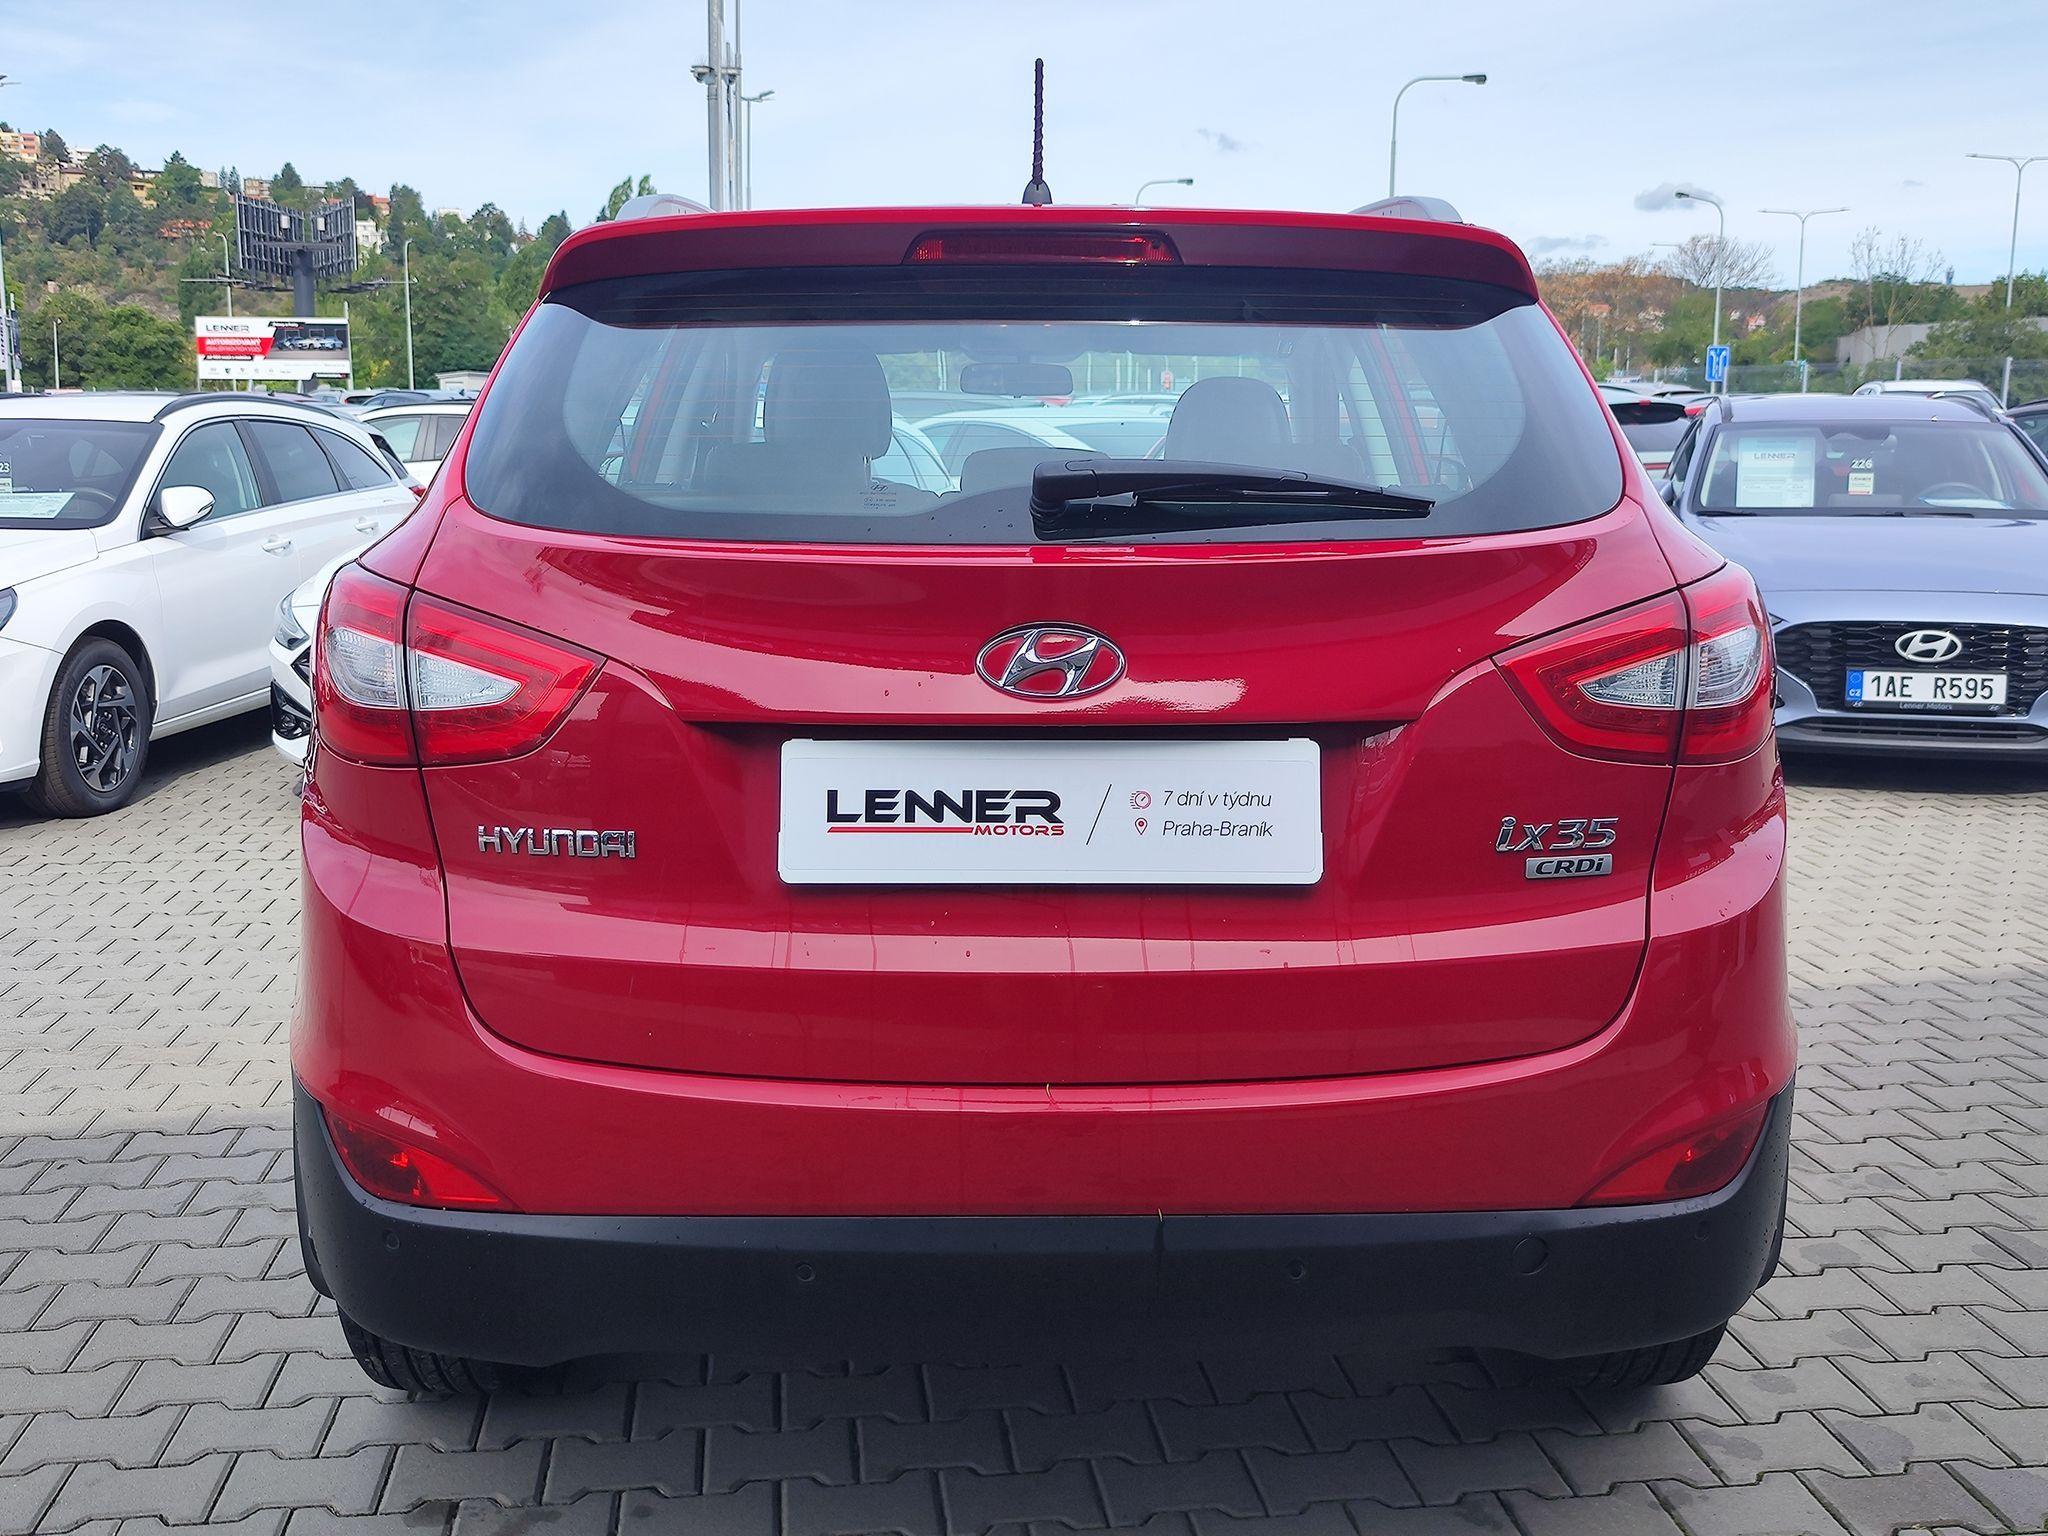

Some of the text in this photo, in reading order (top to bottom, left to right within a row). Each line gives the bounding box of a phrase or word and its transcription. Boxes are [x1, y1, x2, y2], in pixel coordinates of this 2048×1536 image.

[206, 324, 249, 333] LENNER
[1851, 459, 1873, 469] 226
[1849, 688, 1861, 696] CZ
[1871, 675, 1994, 700] 1AE R595
[1900, 702, 1952, 711] Lenner Motors
[827, 789, 1064, 823] LENNER
[1164, 790, 1272, 810] 7 dní v týdnu
[974, 824, 1064, 836] MOTORS
[1162, 820, 1273, 837] Praha-Braník
[477, 825, 635, 858] HYUNDAI
[1535, 857, 1604, 874] CRDi
